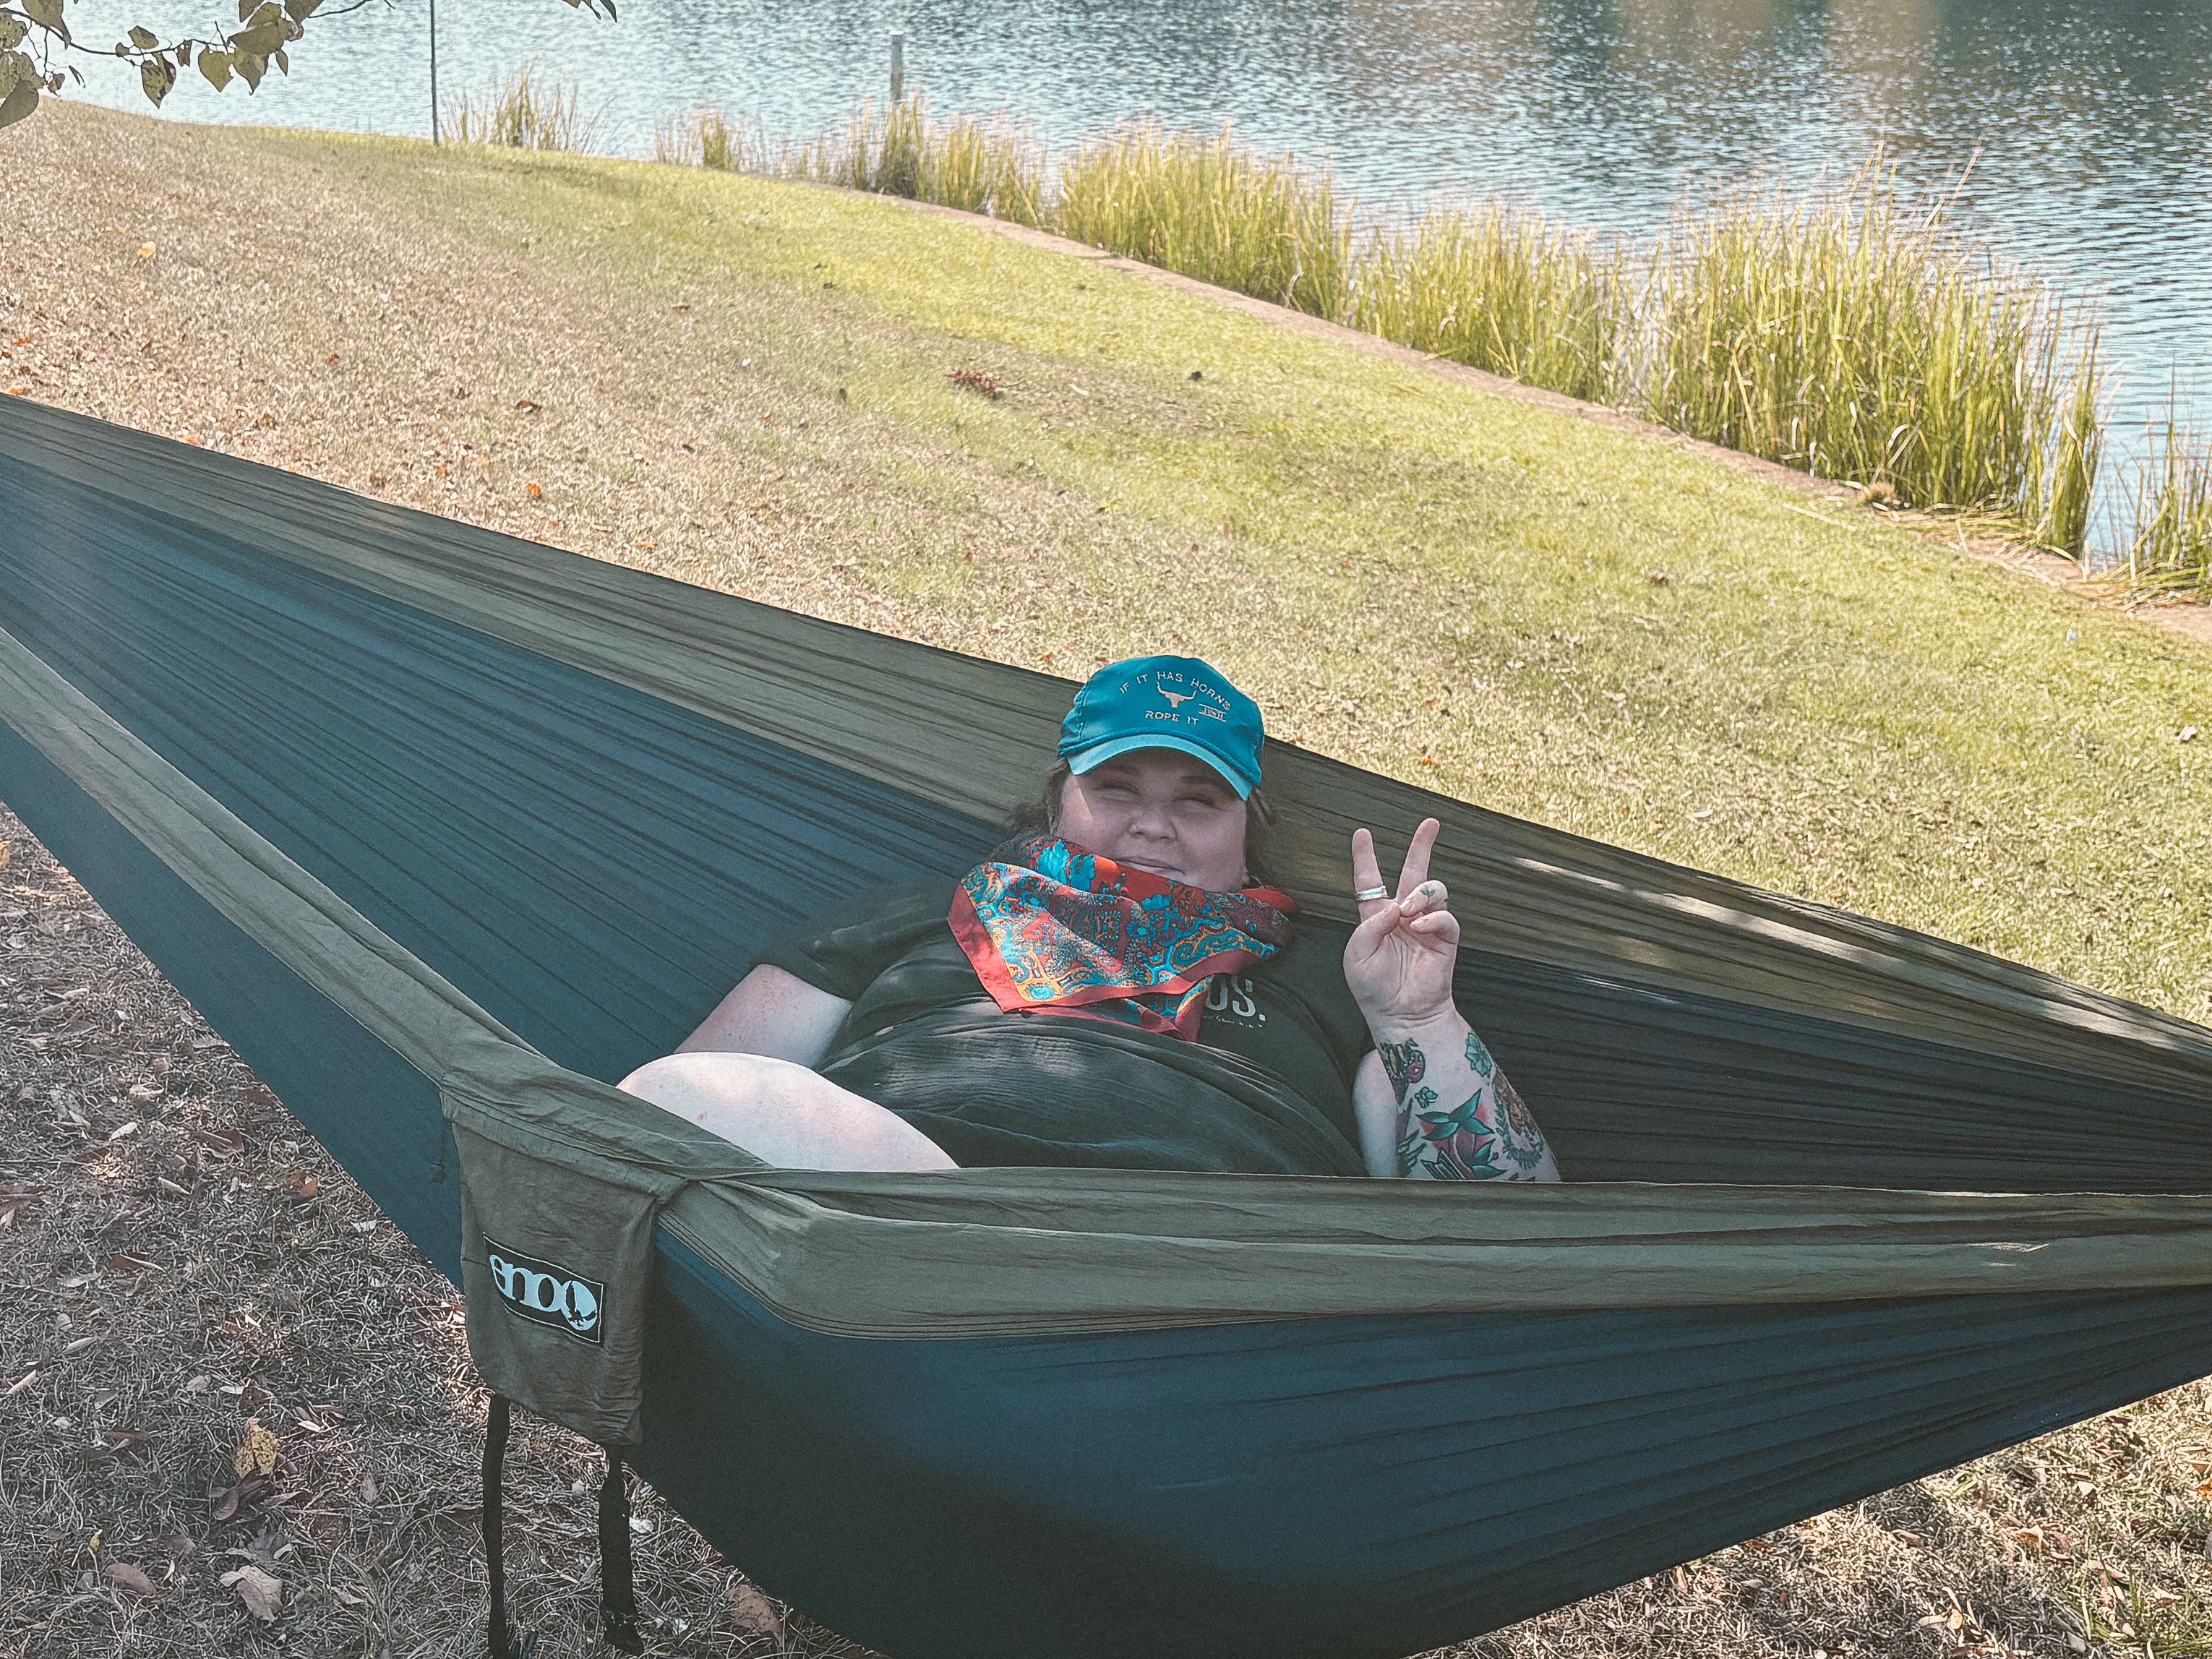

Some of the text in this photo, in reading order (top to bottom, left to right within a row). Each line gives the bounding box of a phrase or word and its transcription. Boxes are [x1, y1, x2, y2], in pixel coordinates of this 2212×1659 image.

[1120, 671, 1231, 711] IF IT HAS HORNS
[1145, 710, 1199, 725] ROPE IT
